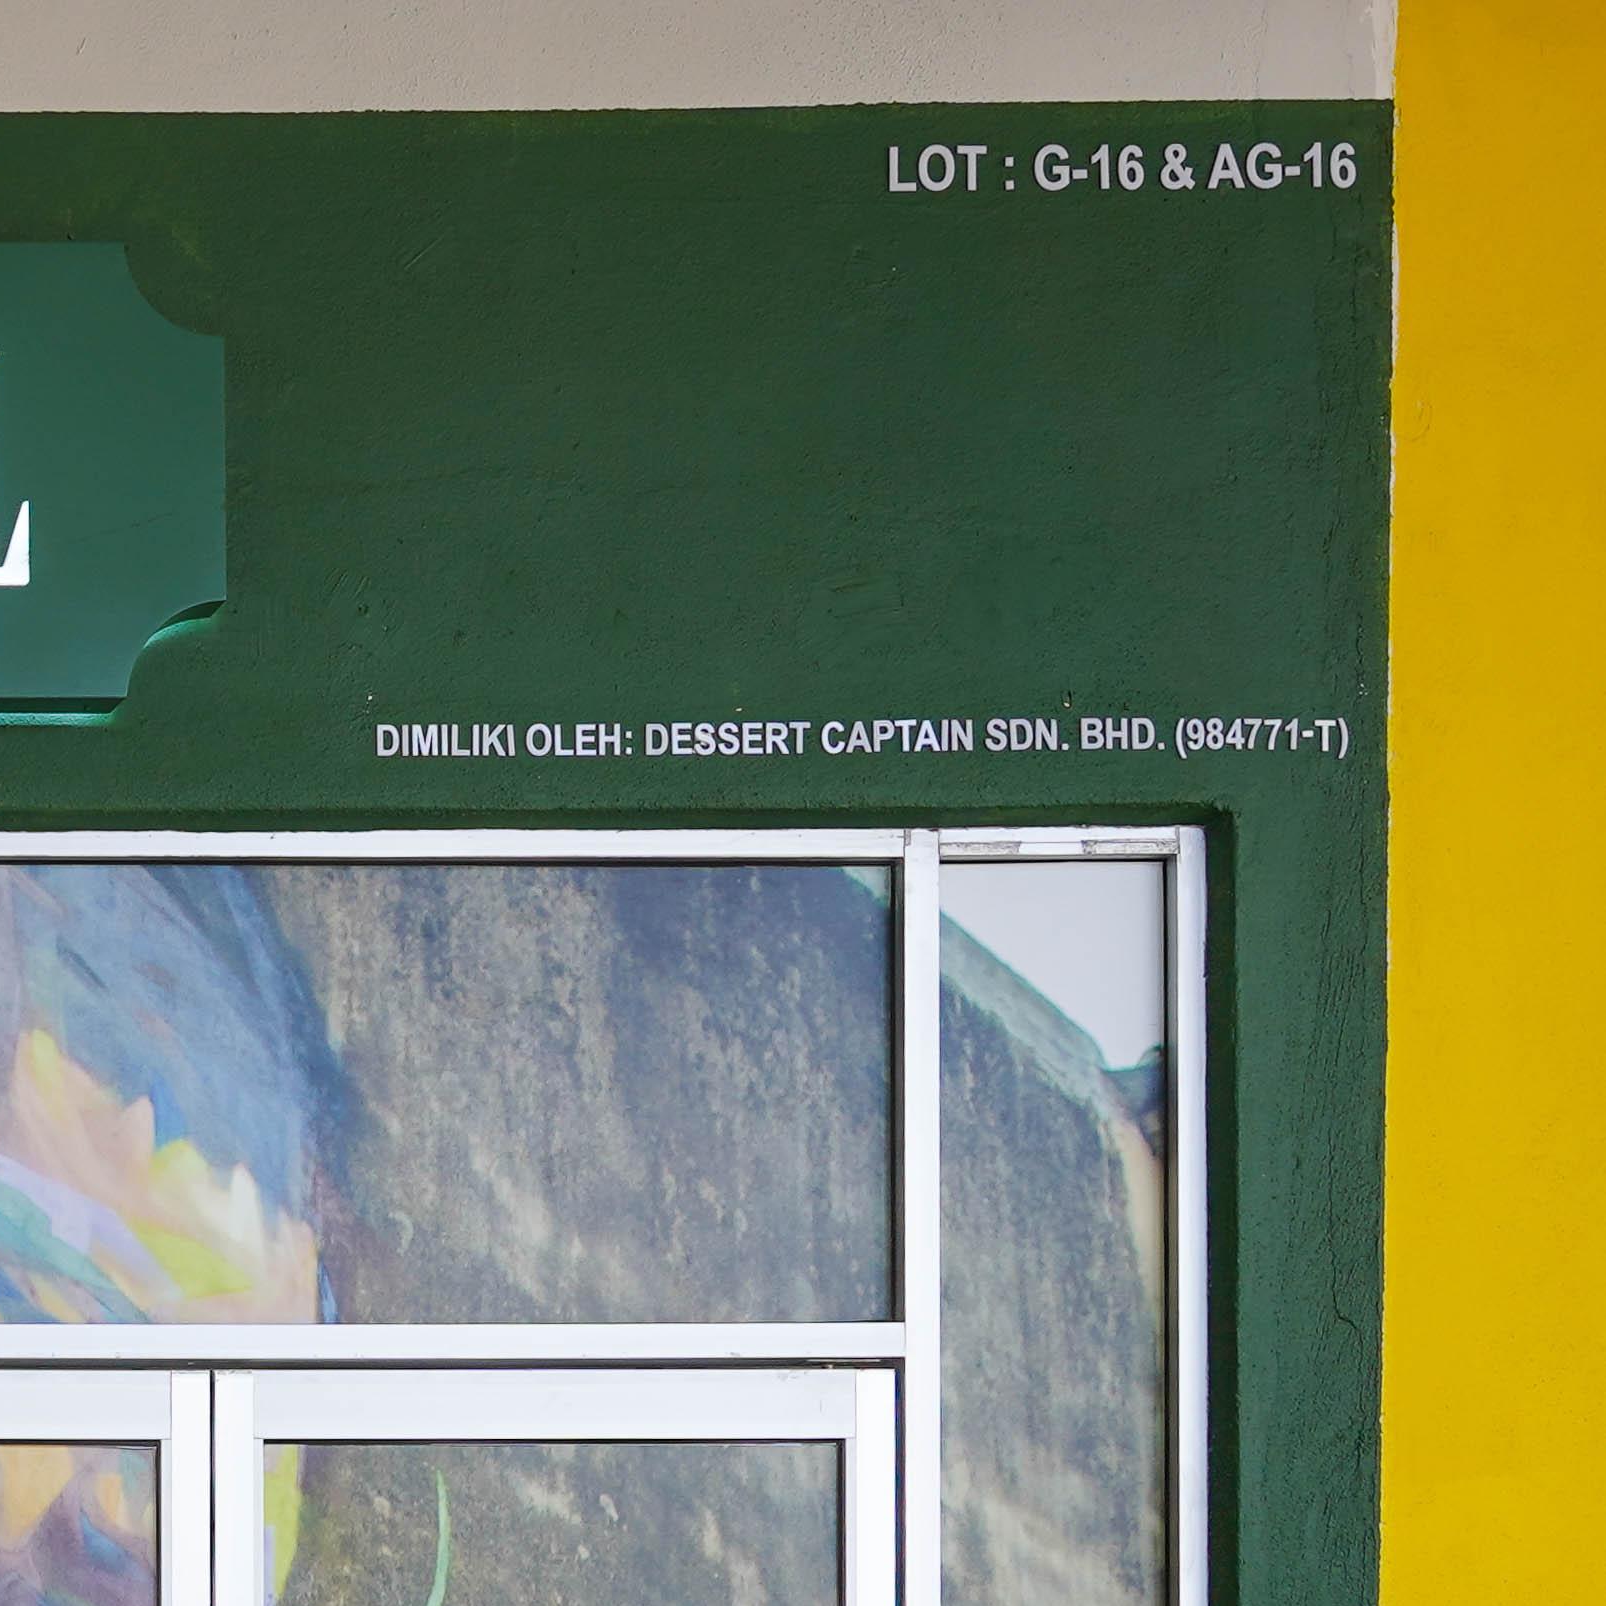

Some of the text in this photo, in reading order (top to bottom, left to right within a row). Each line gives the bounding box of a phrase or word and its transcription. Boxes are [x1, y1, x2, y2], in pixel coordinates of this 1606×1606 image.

[888, 143, 988, 192] LOT
[1033, 142, 1146, 191] G-16
[1159, 142, 1196, 190] &
[1207, 141, 1357, 189] AG-16
[375, 716, 1350, 759] DIMILIKI OLEH: DESSERT CAPTAIN SDN. BHD. (984771-T)
